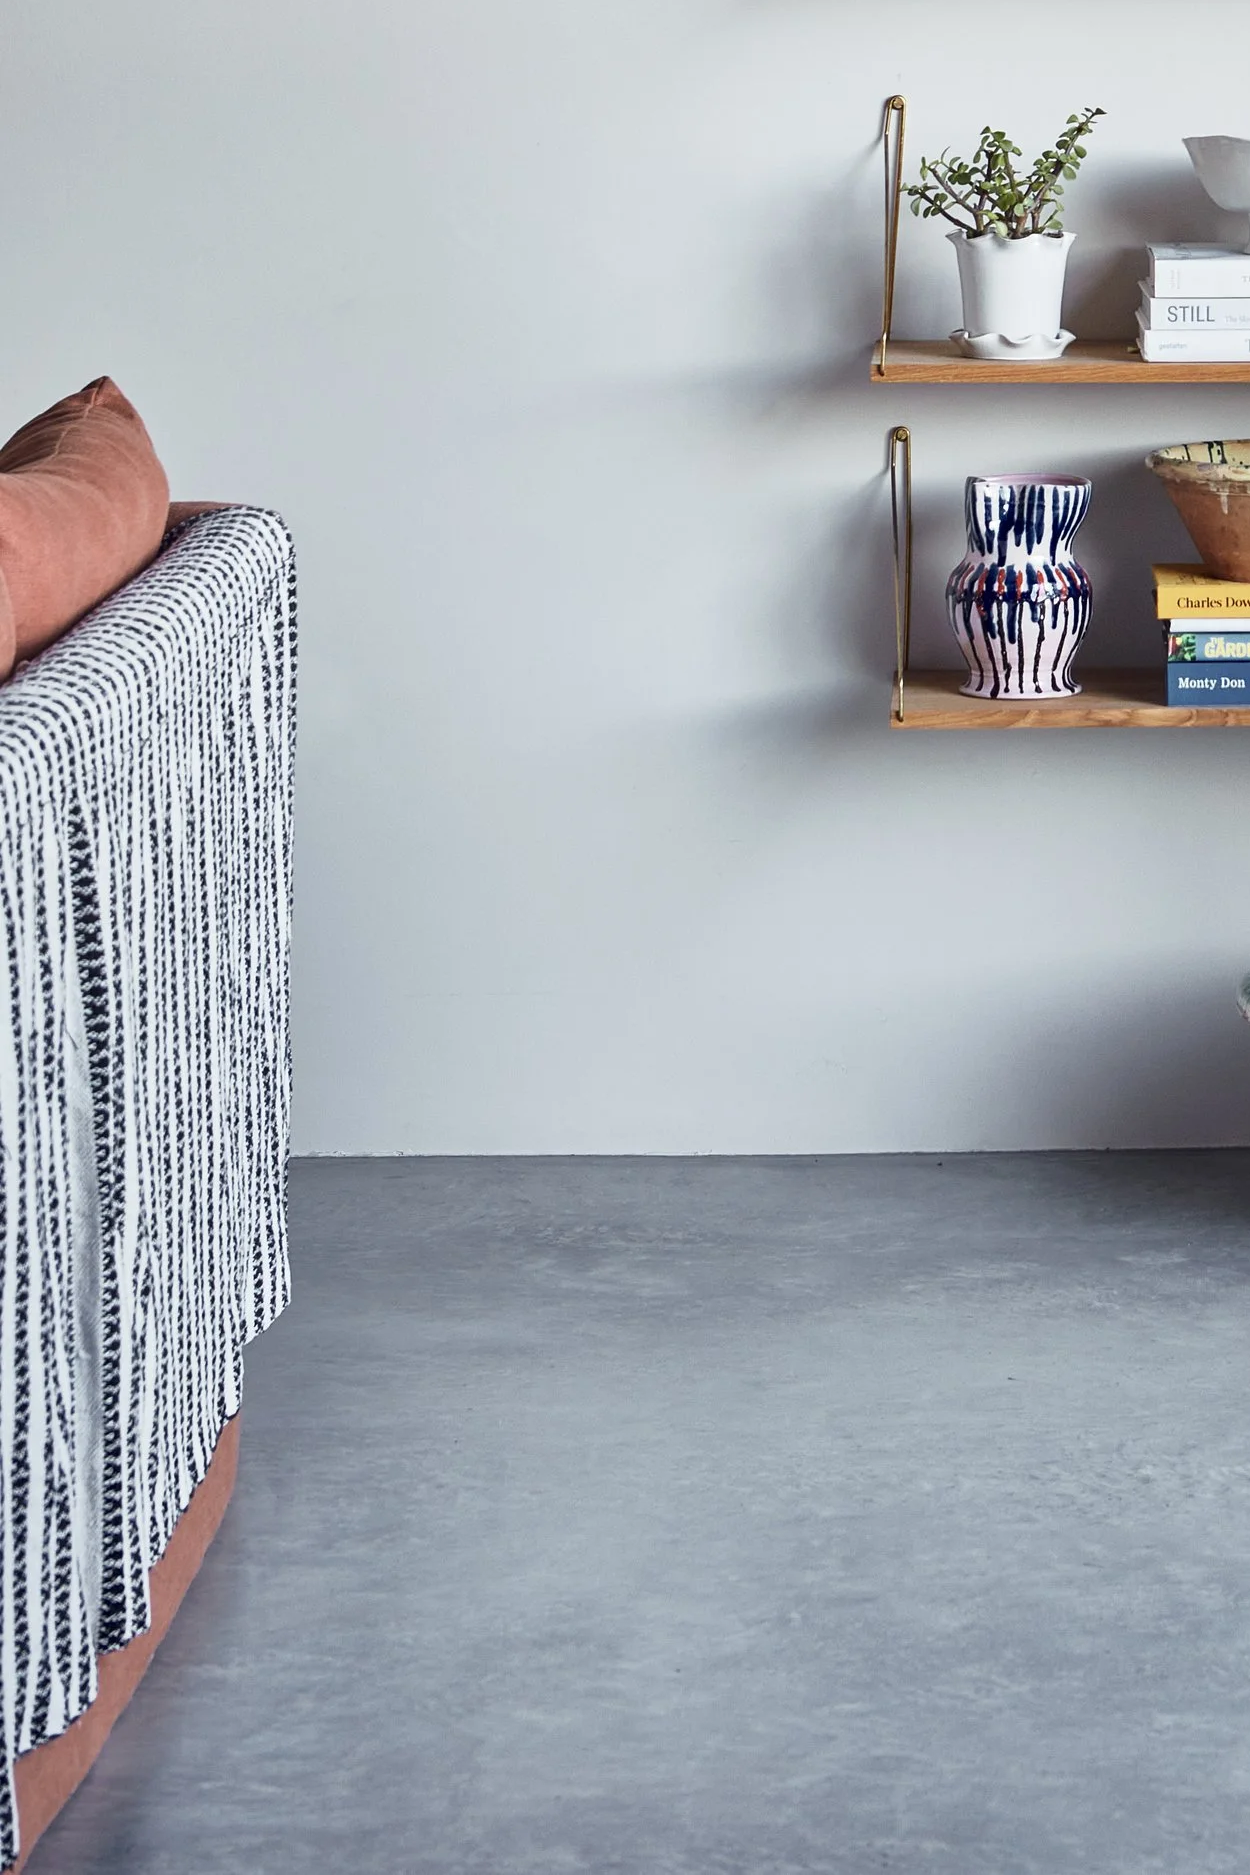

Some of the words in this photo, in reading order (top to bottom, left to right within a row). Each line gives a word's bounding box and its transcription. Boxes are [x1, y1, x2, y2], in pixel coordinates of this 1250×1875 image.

[1167, 305, 1216, 323] STILL
[1177, 597, 1222, 609] Charles
[1178, 677, 1217, 691] Monty
[1221, 677, 1246, 689] Don
